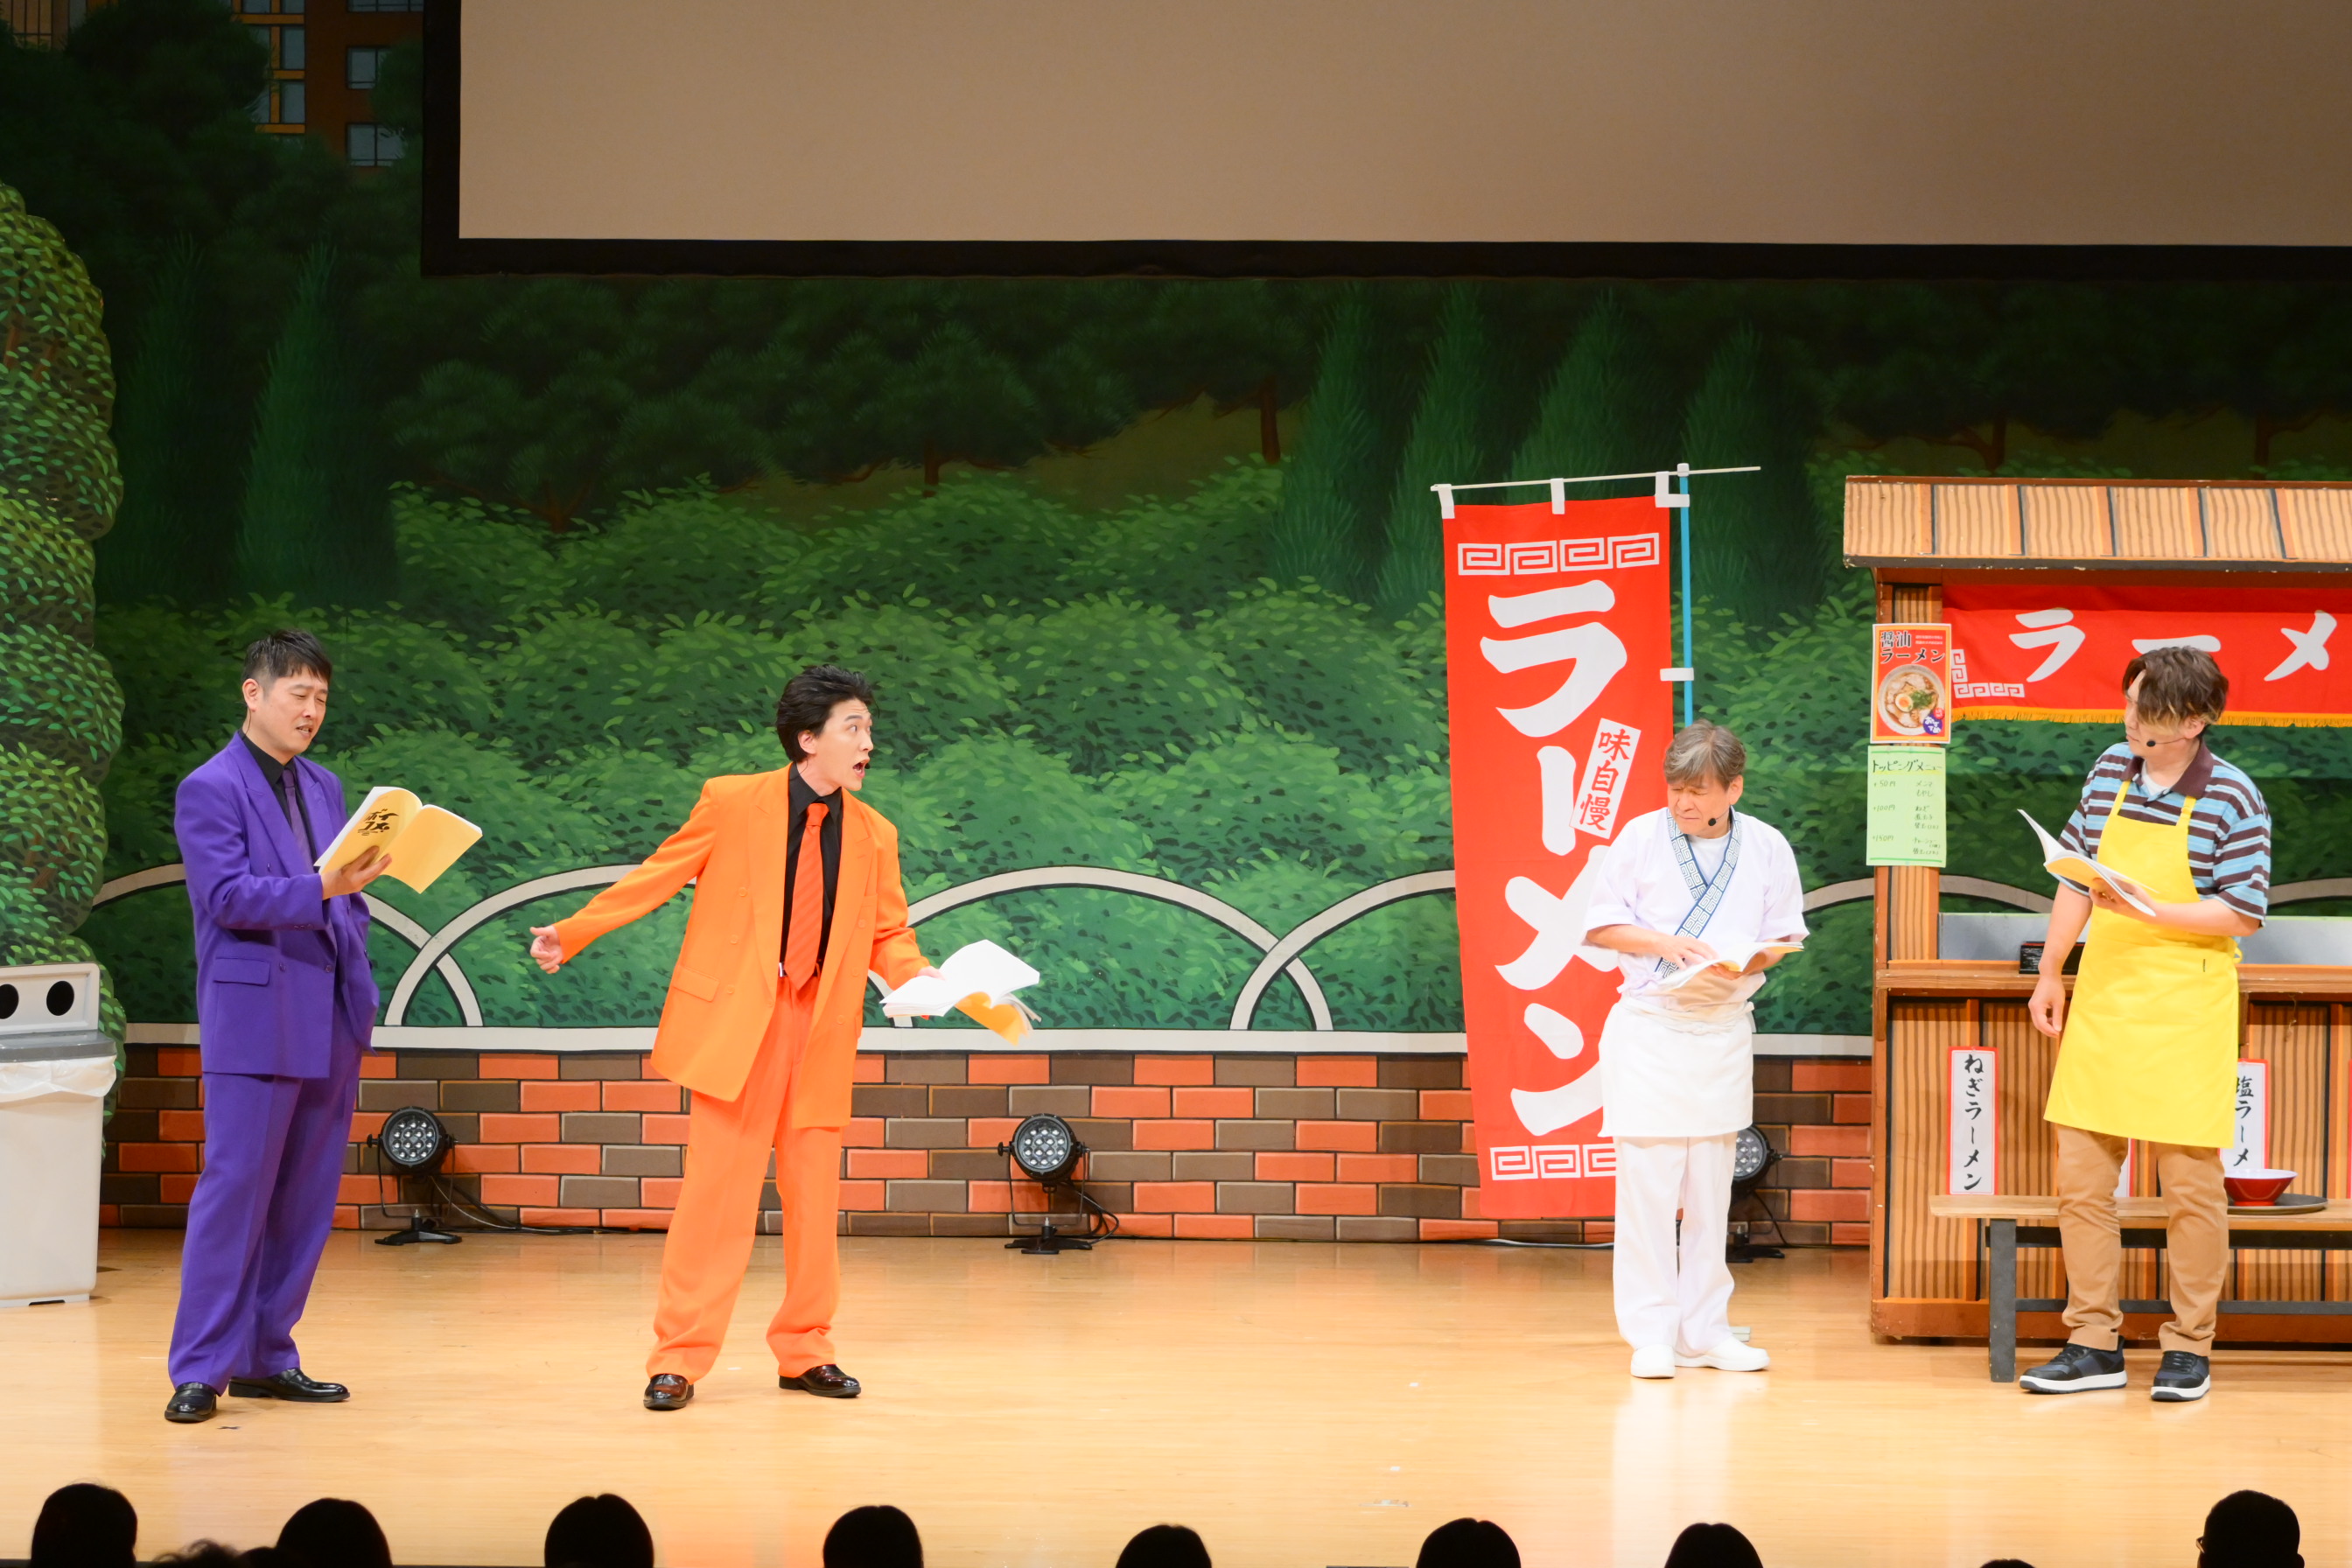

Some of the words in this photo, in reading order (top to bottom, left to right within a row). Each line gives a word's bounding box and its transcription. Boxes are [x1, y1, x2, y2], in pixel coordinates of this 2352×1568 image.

[1880, 631, 1911, 648] 醤油
[1880, 648, 1945, 664] ラーメン
[1578, 728, 1632, 833] 味自慢
[1964, 1054, 1984, 1191] ねぎラーメン
